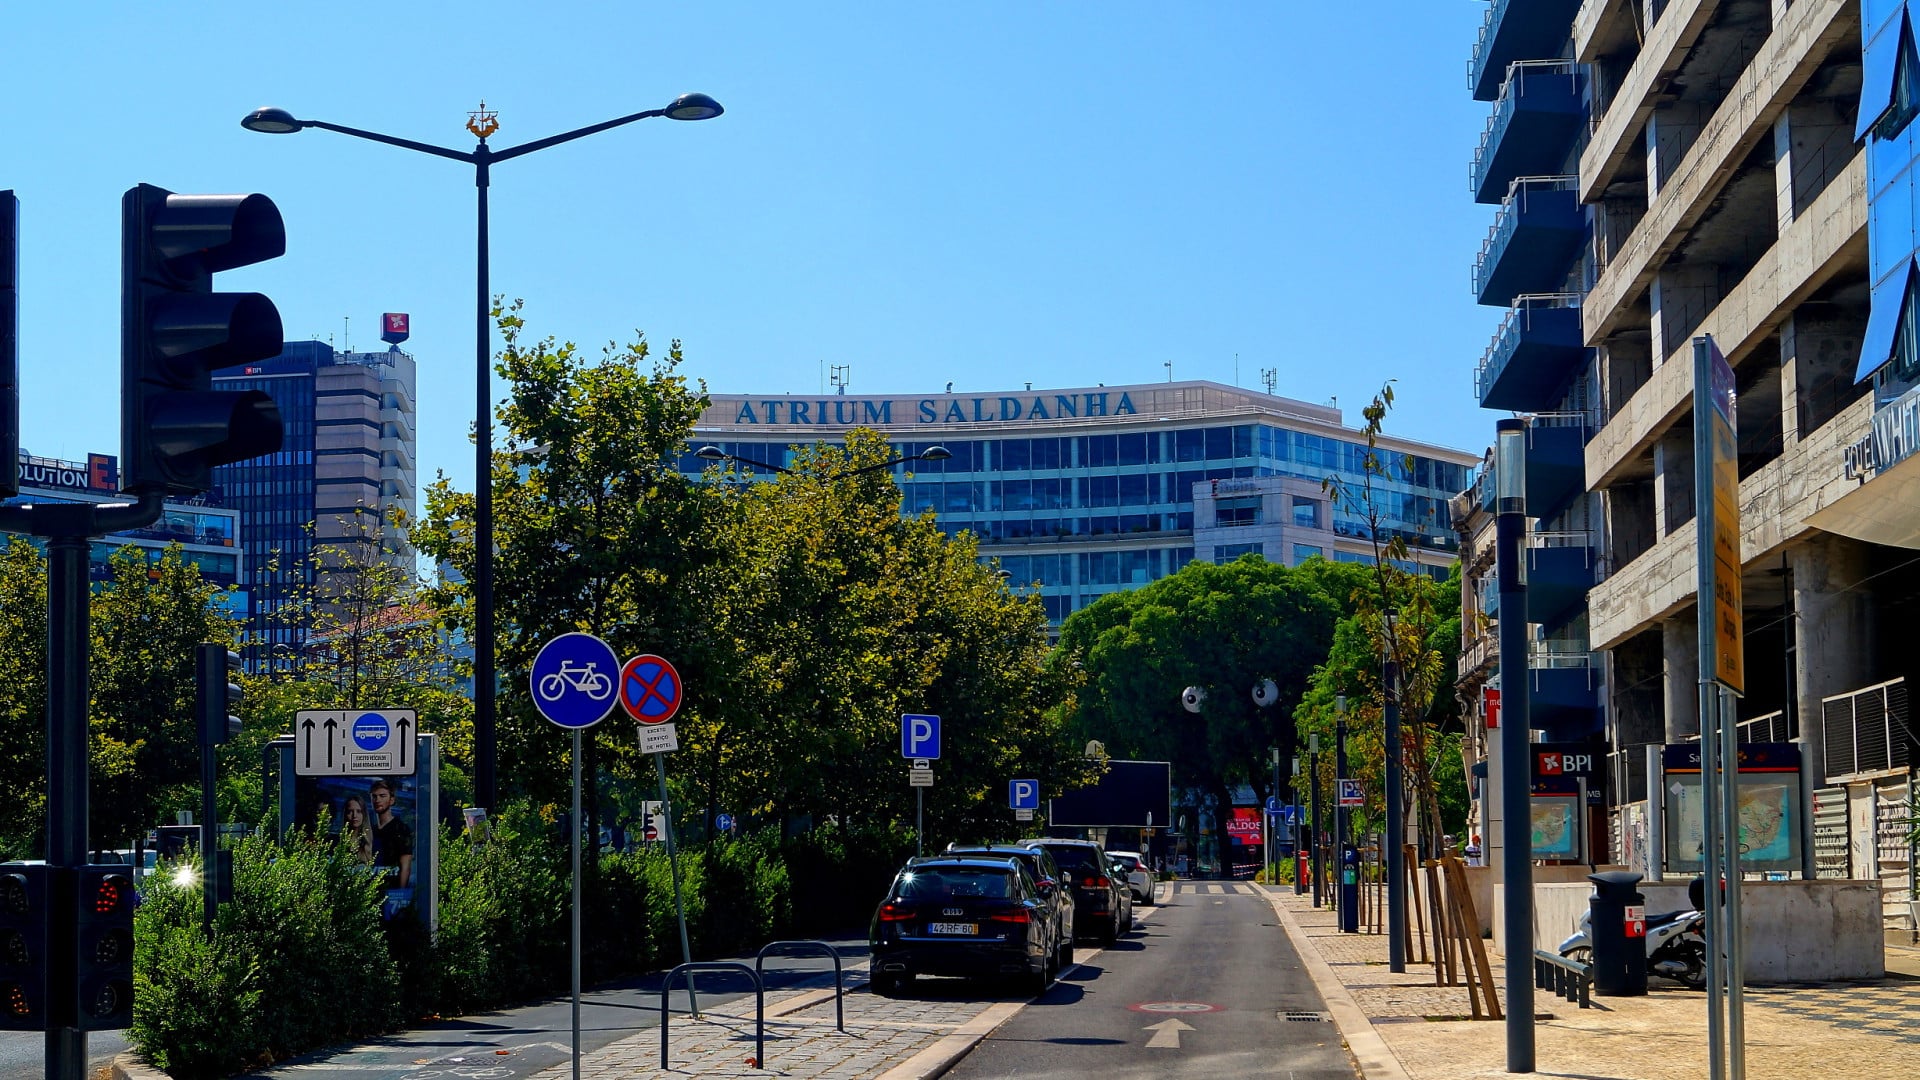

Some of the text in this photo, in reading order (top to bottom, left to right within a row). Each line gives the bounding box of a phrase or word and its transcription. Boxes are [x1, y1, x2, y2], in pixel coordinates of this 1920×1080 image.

[736, 391, 1137, 425] ATRIUM SALDANHA
[1844, 432, 1876, 480] HOTEL
[910, 718, 932, 755] P
[1562, 754, 1593, 772] BPI
[1015, 782, 1033, 807] P
